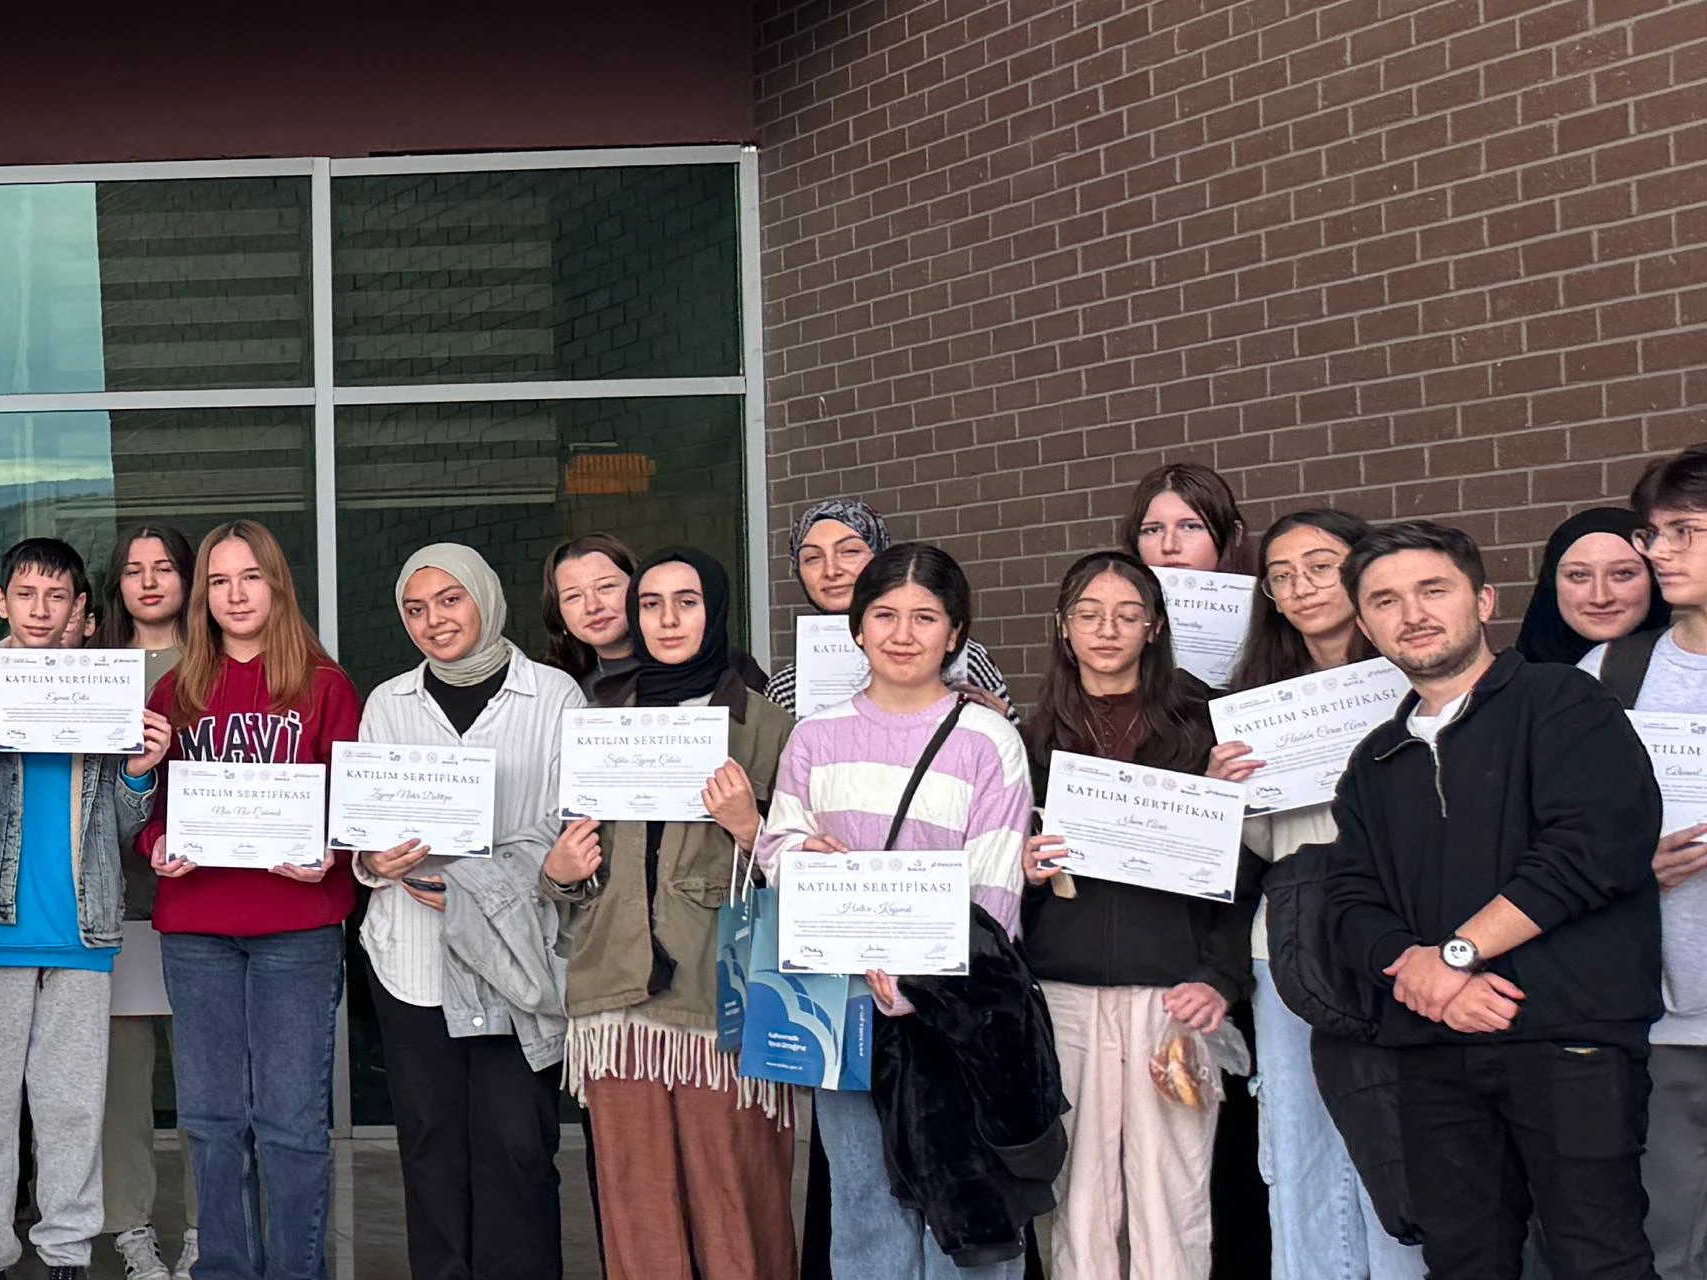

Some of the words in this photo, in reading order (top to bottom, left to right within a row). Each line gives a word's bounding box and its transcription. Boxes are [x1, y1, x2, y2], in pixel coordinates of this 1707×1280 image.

[5, 675, 53, 684] KATILIM
[1234, 712, 1297, 734] KATILIM
[177, 709, 304, 764] MAVİ
[577, 736, 629, 746] KATILIM
[1651, 744, 1702, 756] TILIM
[346, 770, 398, 780] KATILIM
[183, 788, 233, 798] KATILIM
[1066, 784, 1127, 803] KATILIM
[797, 881, 857, 892] KATILIM
